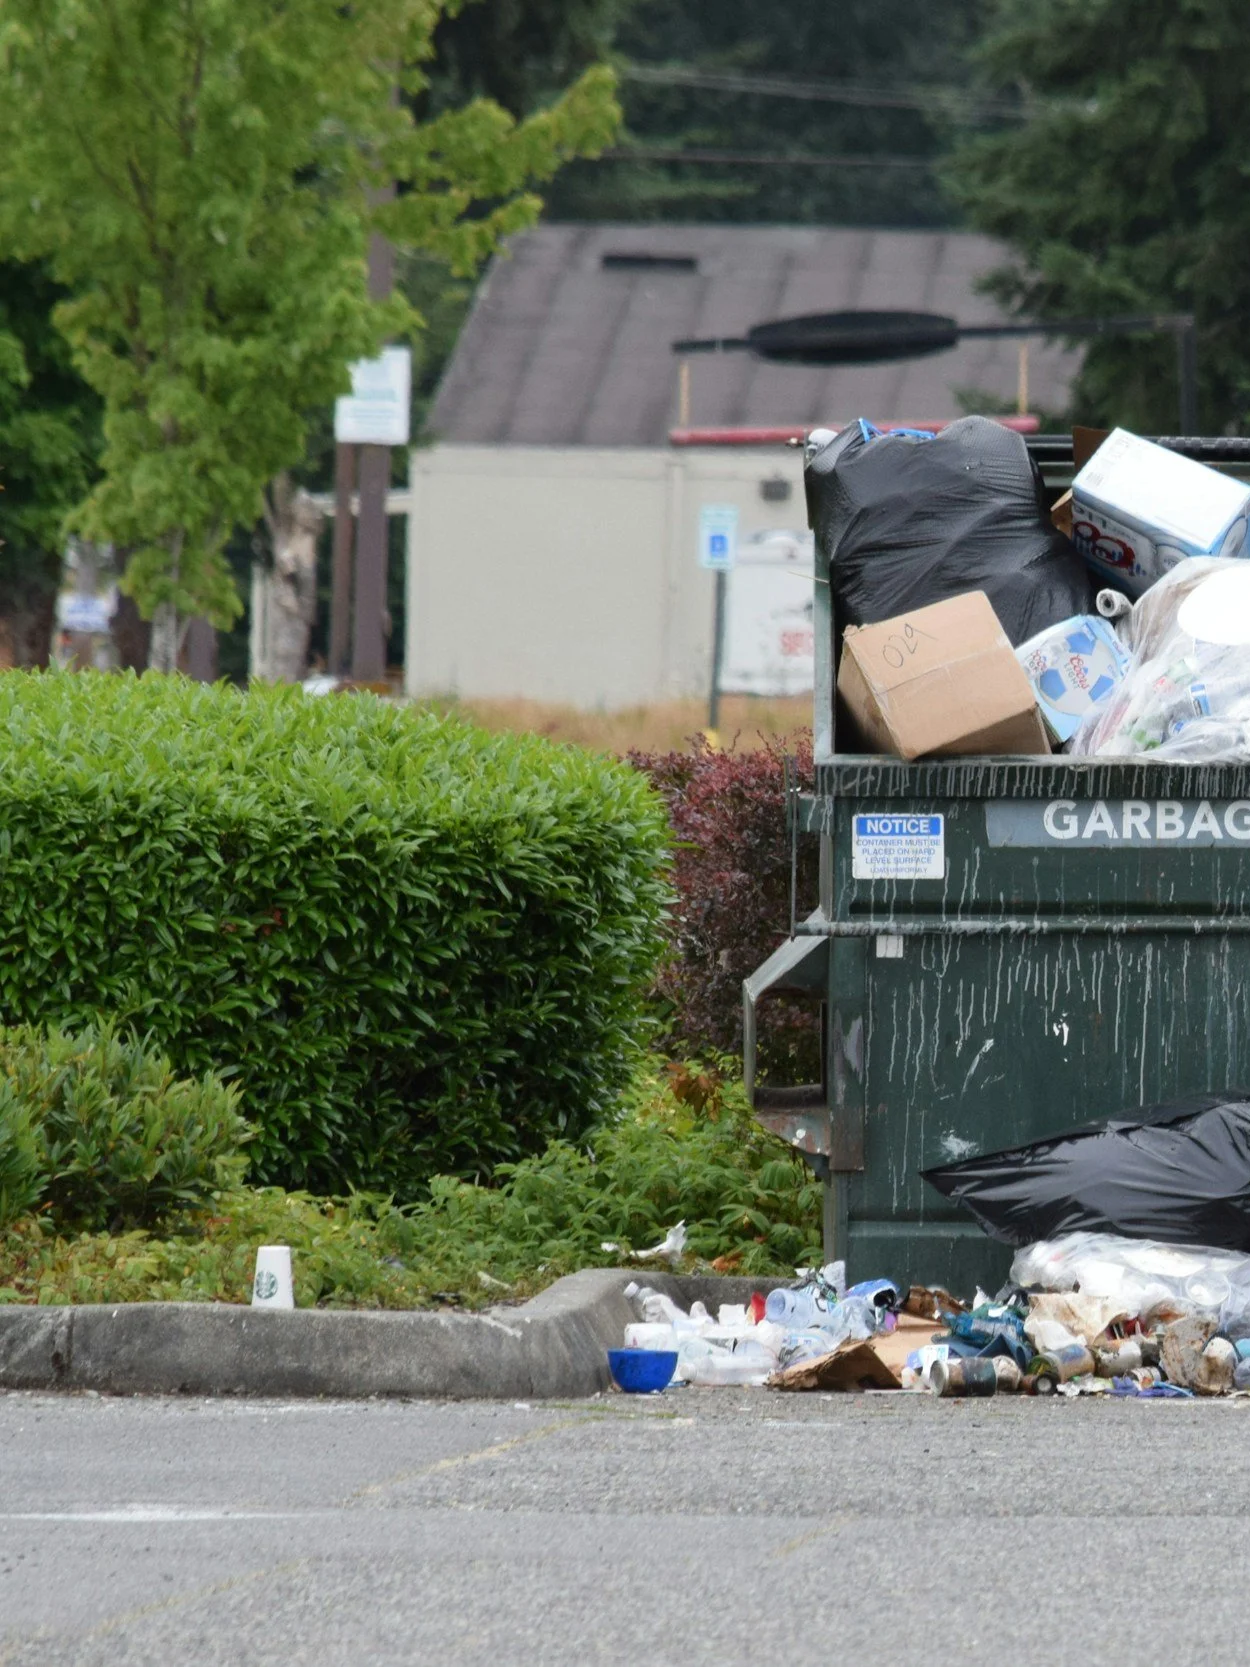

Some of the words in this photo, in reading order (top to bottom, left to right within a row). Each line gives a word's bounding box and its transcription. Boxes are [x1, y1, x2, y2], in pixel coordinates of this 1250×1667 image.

[1069, 654, 1090, 689] Coors
[866, 819, 931, 834] NOTICE
[856, 839, 903, 847] CONTAINER
[905, 839, 928, 847] MUST
[930, 839, 941, 847] BE
[862, 848, 895, 856] PLACED
[897, 848, 910, 856] ON
[911, 848, 936, 856] HARD
[865, 857, 892, 865] LEVEL
[893, 857, 932, 865] SURFACE
